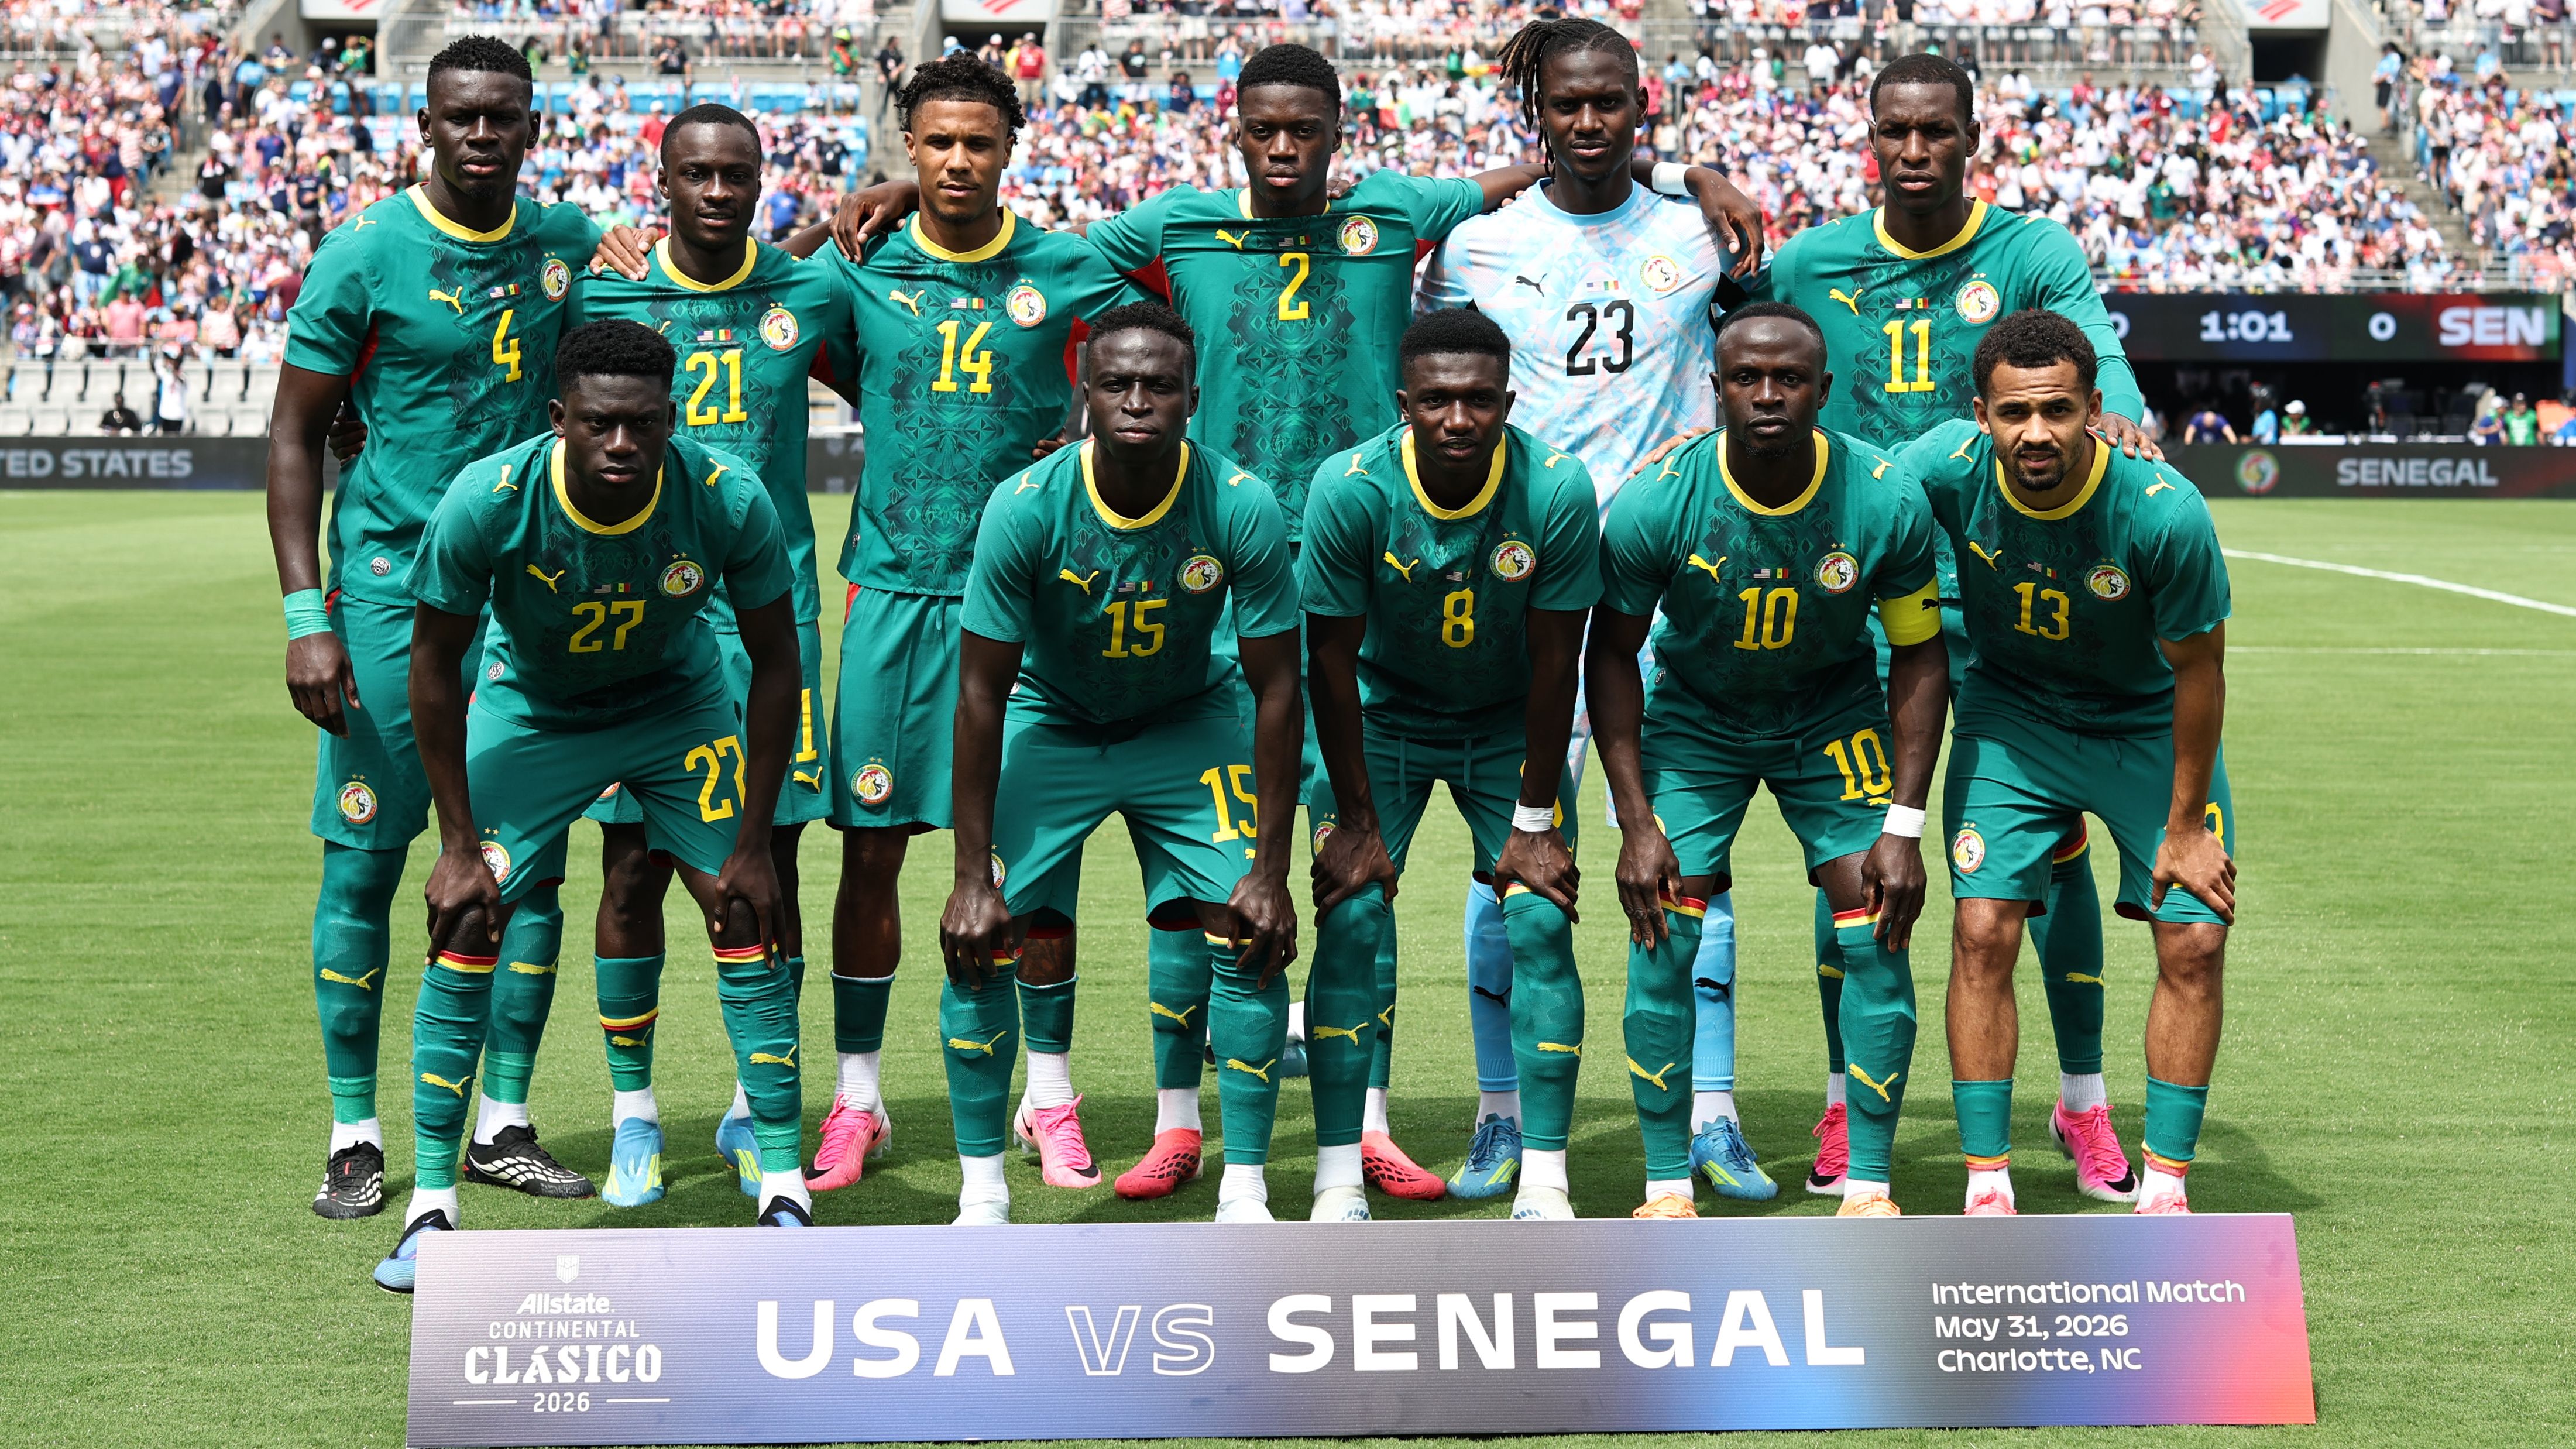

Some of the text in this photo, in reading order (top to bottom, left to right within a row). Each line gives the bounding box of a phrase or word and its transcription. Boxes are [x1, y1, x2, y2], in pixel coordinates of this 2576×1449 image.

[1277, 252, 1310, 321] 2
[492, 308, 523, 383] 4
[1566, 300, 1634, 376] 23
[2200, 310, 2293, 342] 1:01
[2368, 312, 2397, 341] 0
[2438, 305, 2547, 346] SEN
[932, 324, 993, 394] 14
[1884, 322, 1935, 393] 11
[686, 351, 747, 427] 21
[61, 449, 194, 478] STATES
[2336, 458, 2499, 487] SENEGAL
[569, 600, 646, 653] 27
[1102, 599, 1169, 658] 15
[1442, 588, 1474, 648] 8
[1733, 587, 1799, 650] 10
[2013, 582, 2070, 640] 13
[788, 688, 818, 764] 1
[684, 735, 746, 823] 27
[1823, 727, 1892, 801] 10
[1200, 764, 1258, 839] 15
[1932, 1280, 2245, 1304] International Match
[489, 1320, 640, 1339] CONTINENTAL
[756, 1290, 1866, 1379] USA VS SENEGAL
[1935, 1314, 2129, 1341] May 31, 2026
[464, 1344, 662, 1384] CLÁSICO
[1938, 1348, 2142, 1374] Charlotte, NC
[533, 1392, 590, 1412] 2026
